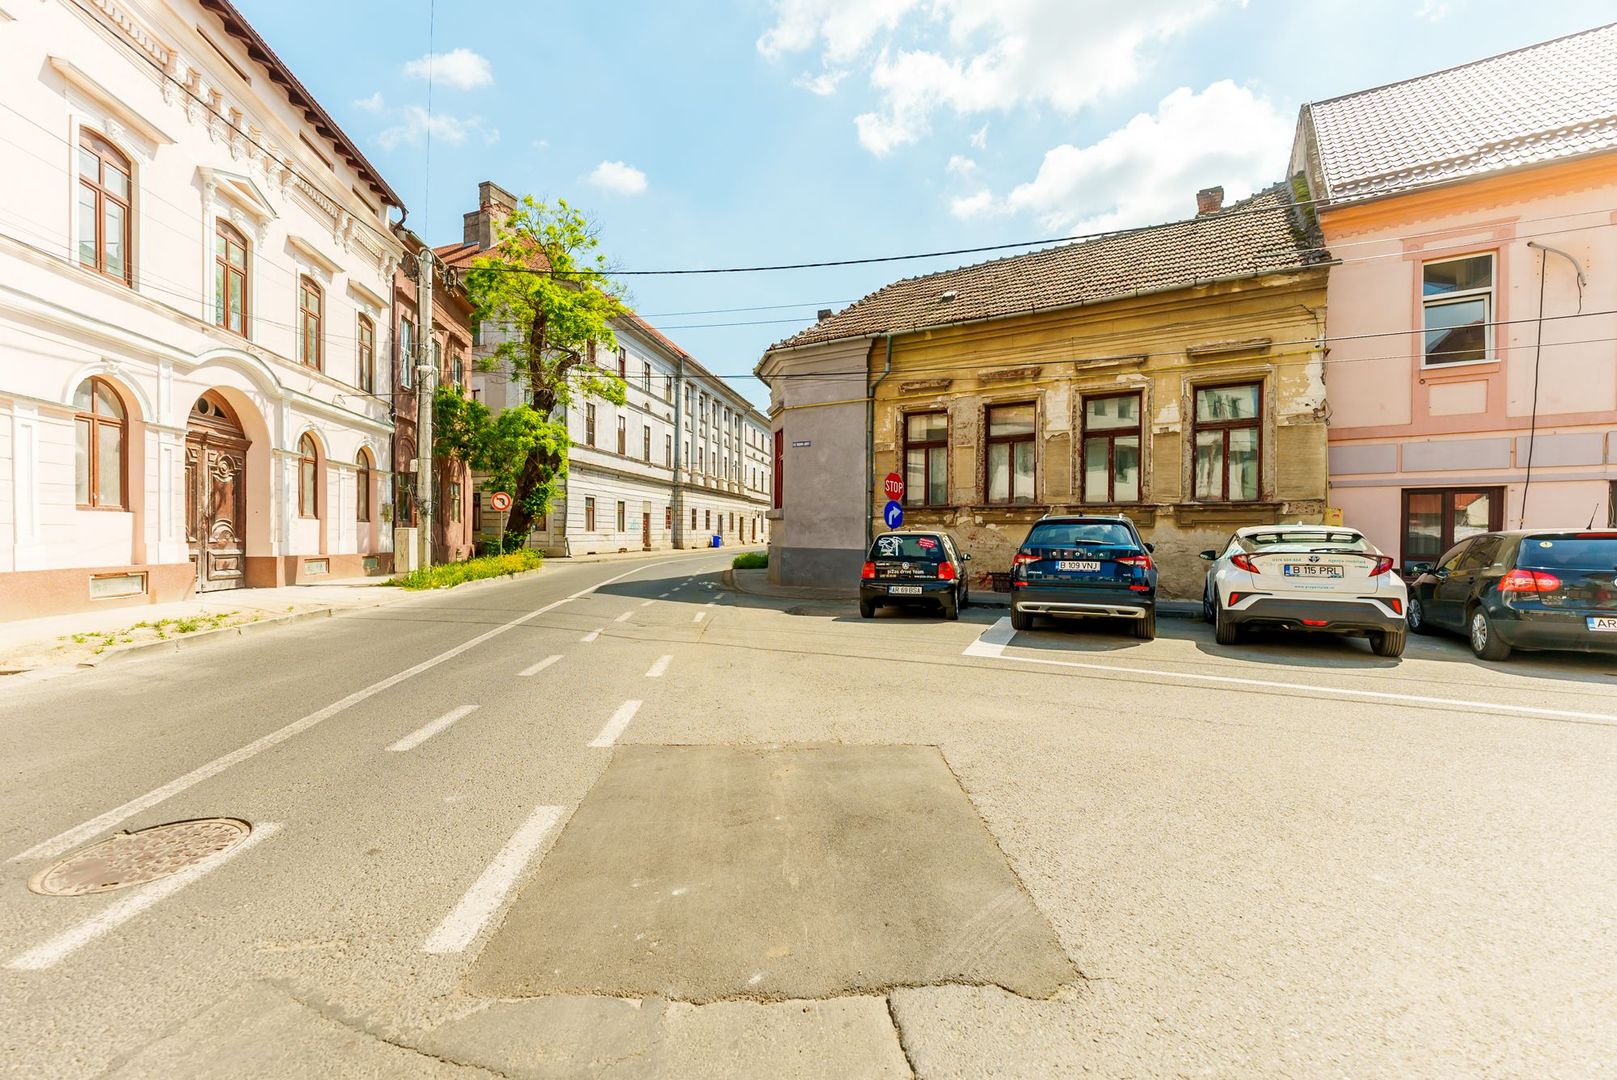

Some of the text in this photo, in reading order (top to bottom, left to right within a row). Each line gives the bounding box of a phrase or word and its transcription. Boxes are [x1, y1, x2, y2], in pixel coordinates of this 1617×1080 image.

[885, 479, 903, 494] STOP
[1293, 566, 1339, 575] B 115 PRL
[1597, 620, 1617, 628] AR
